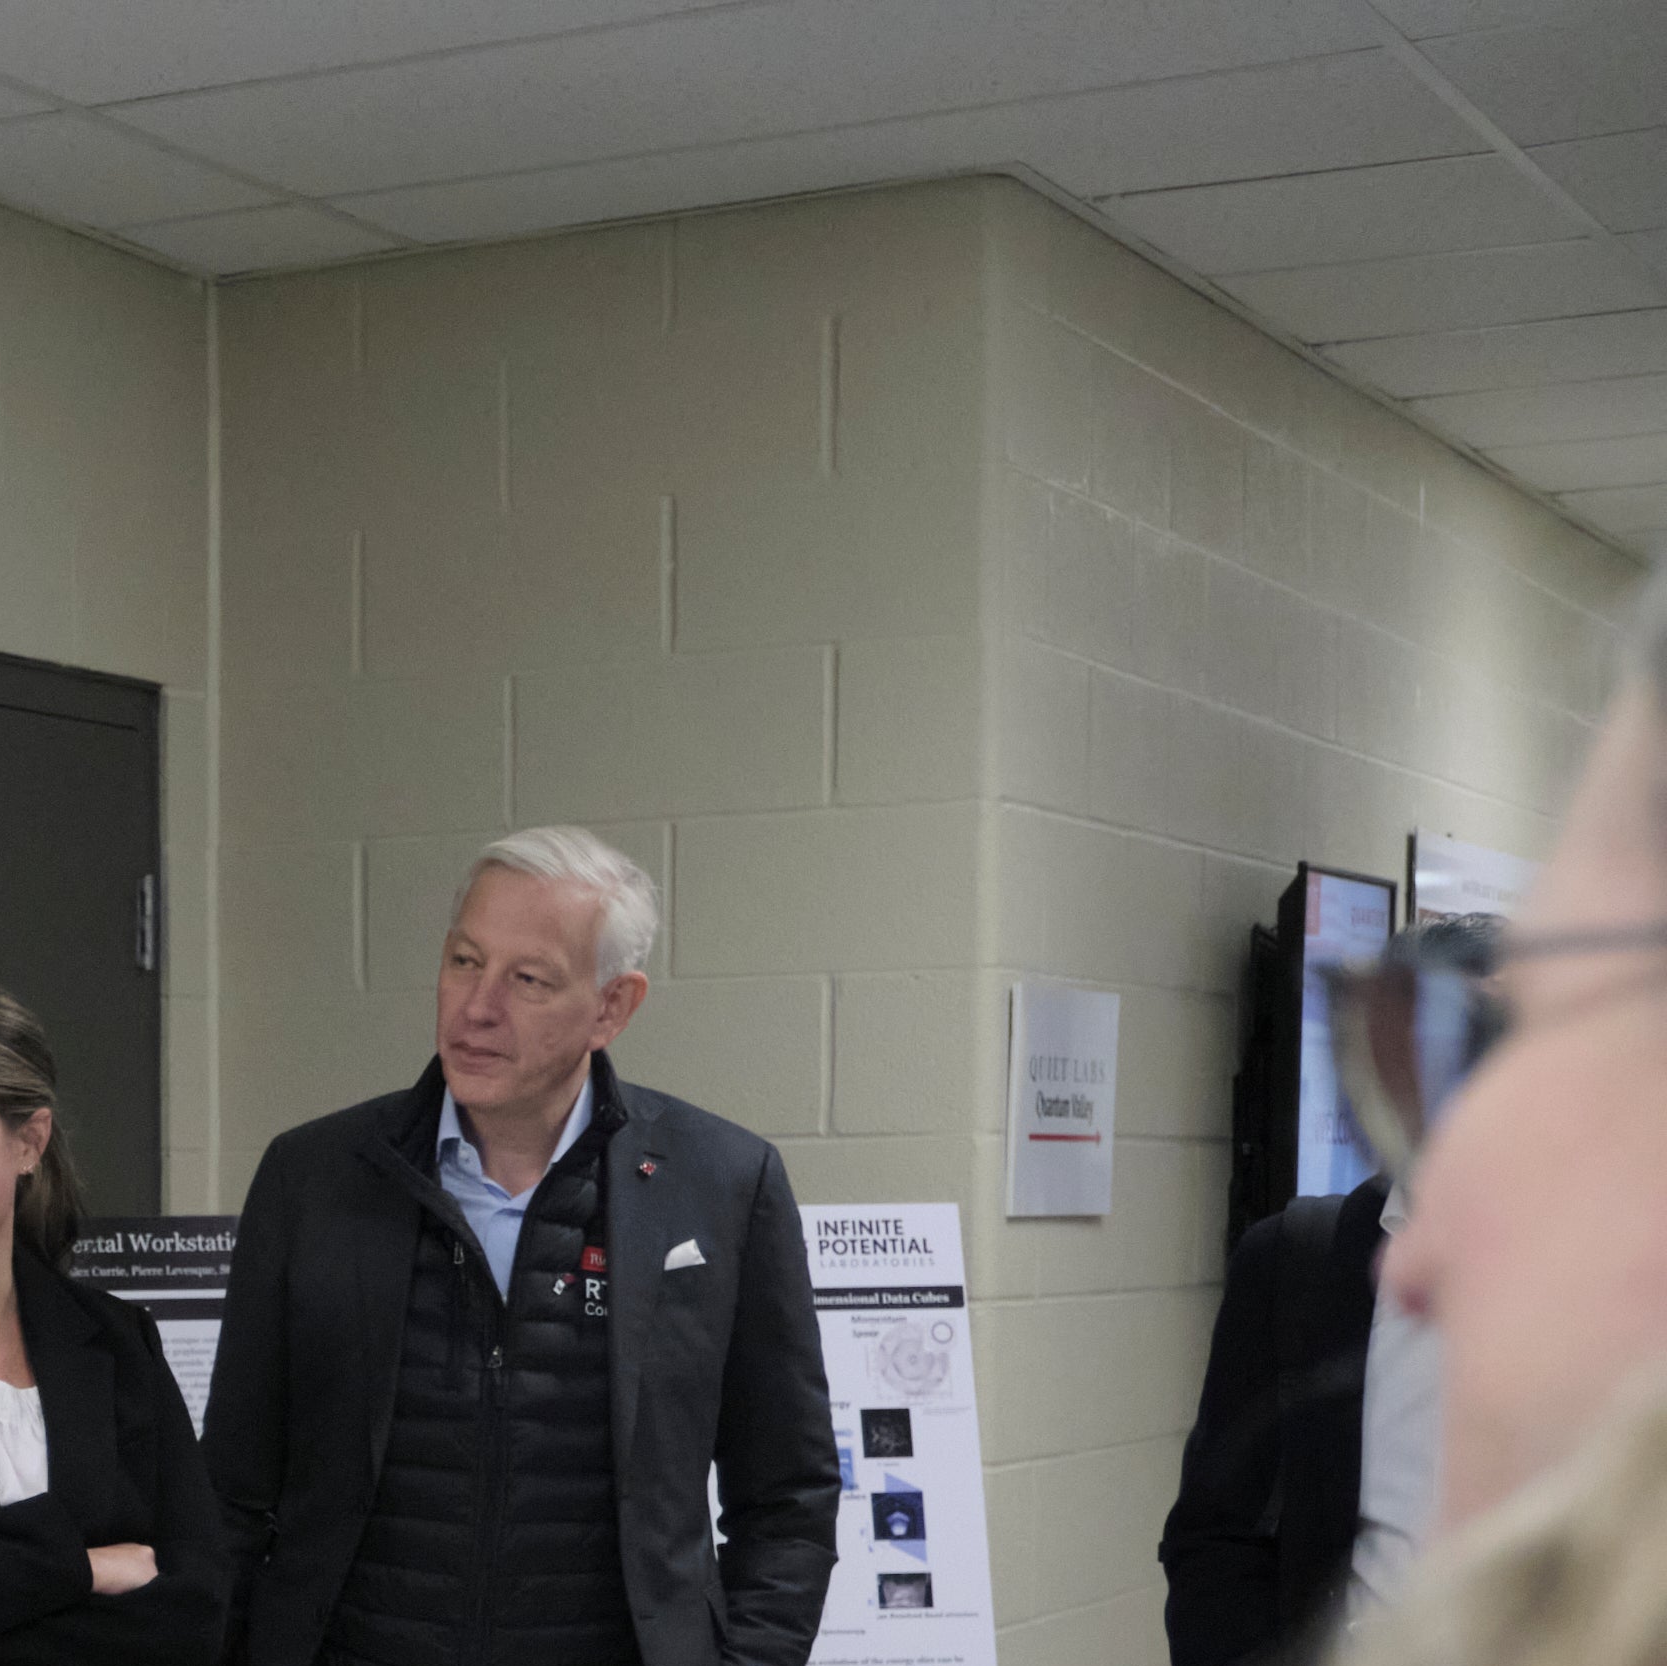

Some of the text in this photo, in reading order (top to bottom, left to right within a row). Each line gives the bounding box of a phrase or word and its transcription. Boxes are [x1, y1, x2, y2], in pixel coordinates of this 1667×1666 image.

[817, 1219, 904, 1236] INFINITE
[819, 1238, 934, 1255] POTENTIAL
[820, 1257, 936, 1268] LABORATORIES
[882, 1292, 910, 1304] Data
[912, 1291, 950, 1304] Cubes
